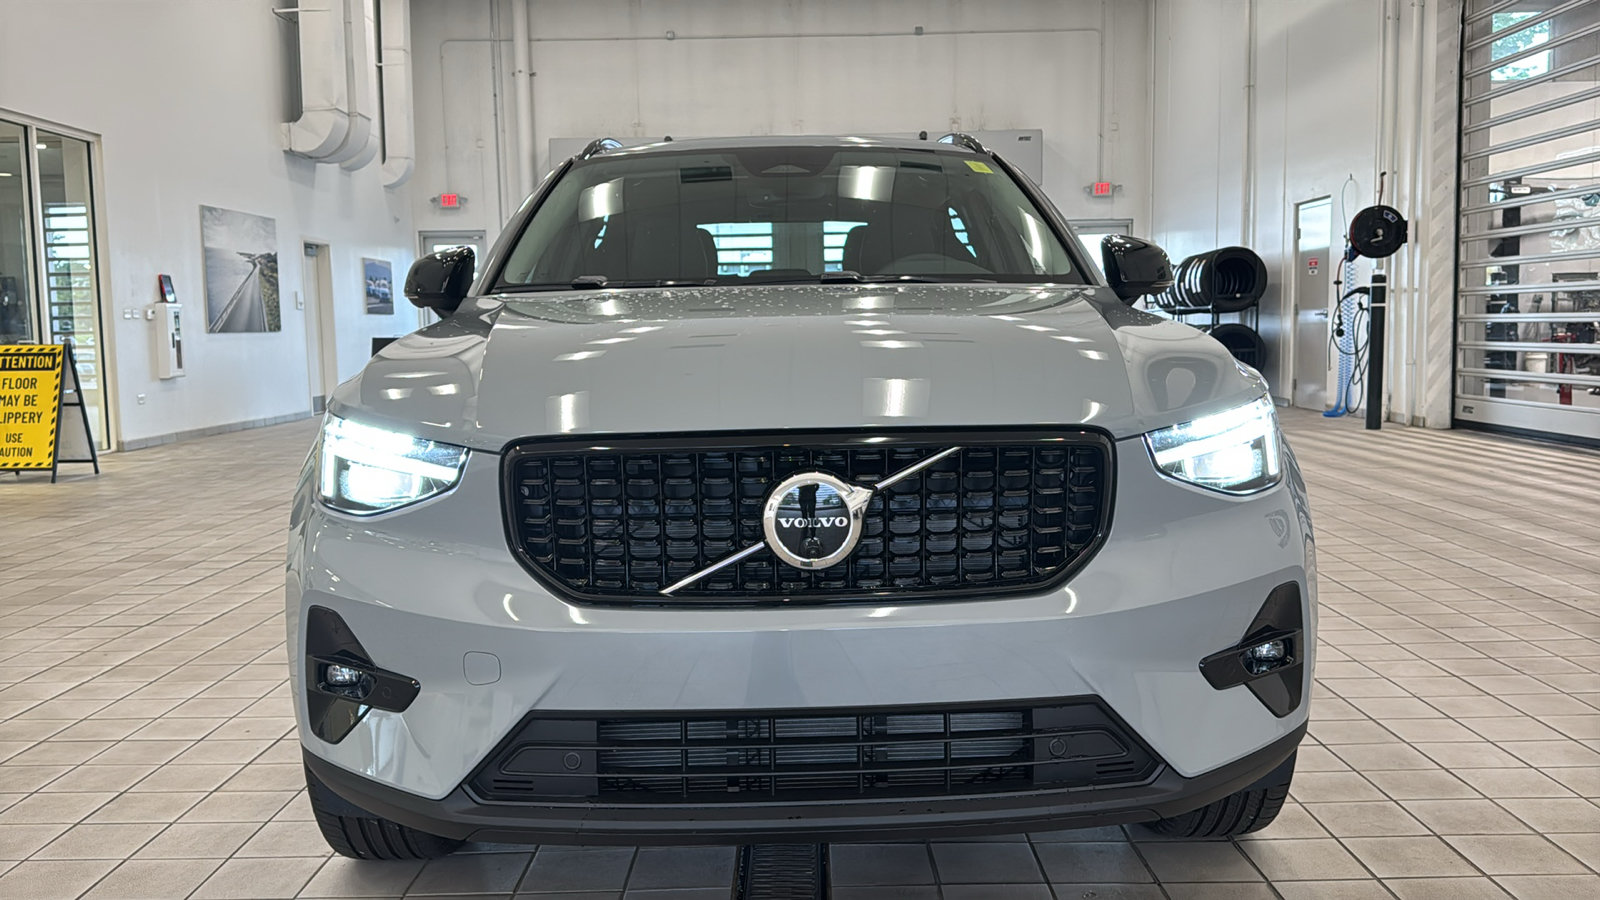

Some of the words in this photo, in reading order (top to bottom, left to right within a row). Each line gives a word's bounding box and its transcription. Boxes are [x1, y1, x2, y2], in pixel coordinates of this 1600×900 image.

[0, 355, 53, 369] TTENTION
[2, 377, 38, 390] FLOOR
[23, 394, 38, 407] BE
[0, 411, 43, 424] IPPERY
[5, 432, 23, 443] USE
[0, 447, 33, 458] AUTION
[777, 516, 849, 528] VOLVO
